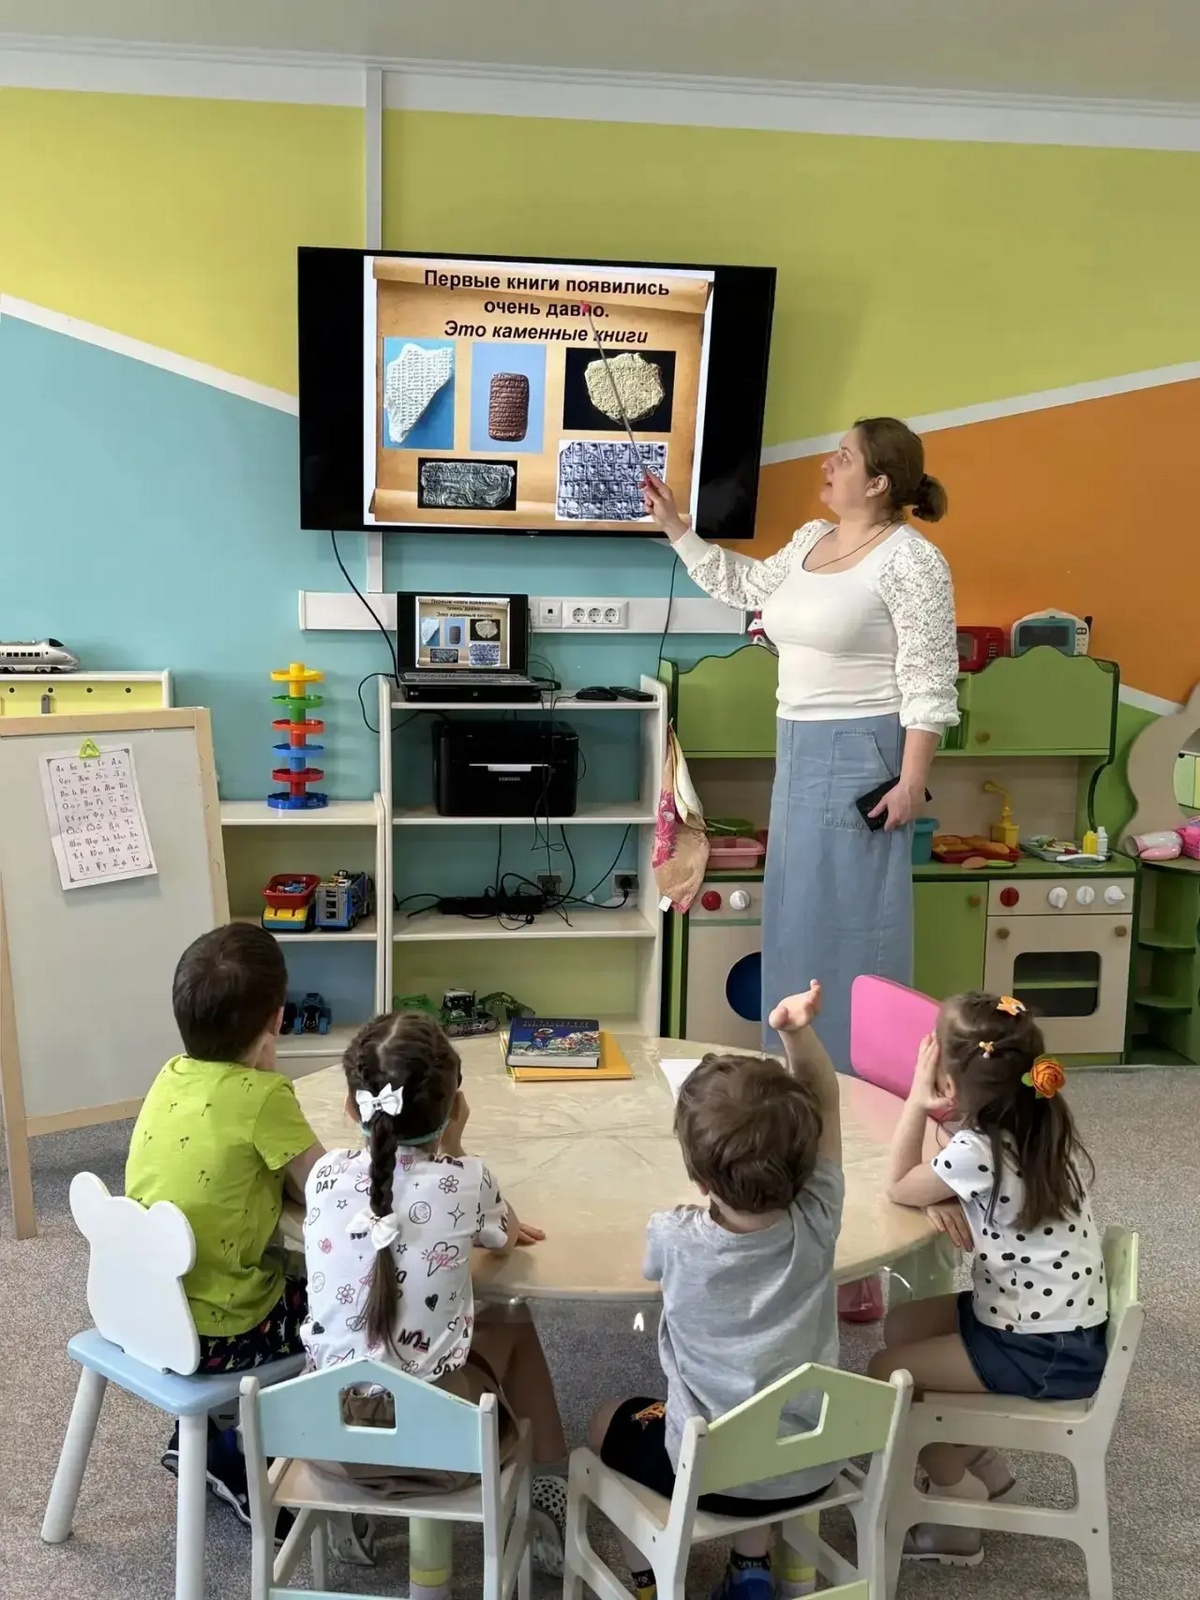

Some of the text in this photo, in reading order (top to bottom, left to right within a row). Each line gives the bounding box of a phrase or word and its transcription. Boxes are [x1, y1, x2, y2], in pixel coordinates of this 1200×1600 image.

[424, 269, 670, 296] Первые книги появились
[484, 300, 541, 315] очень
[444, 320, 649, 343] Это каменные книги
[316, 1178, 338, 1194] DAY
[398, 1328, 432, 1353] FUN
